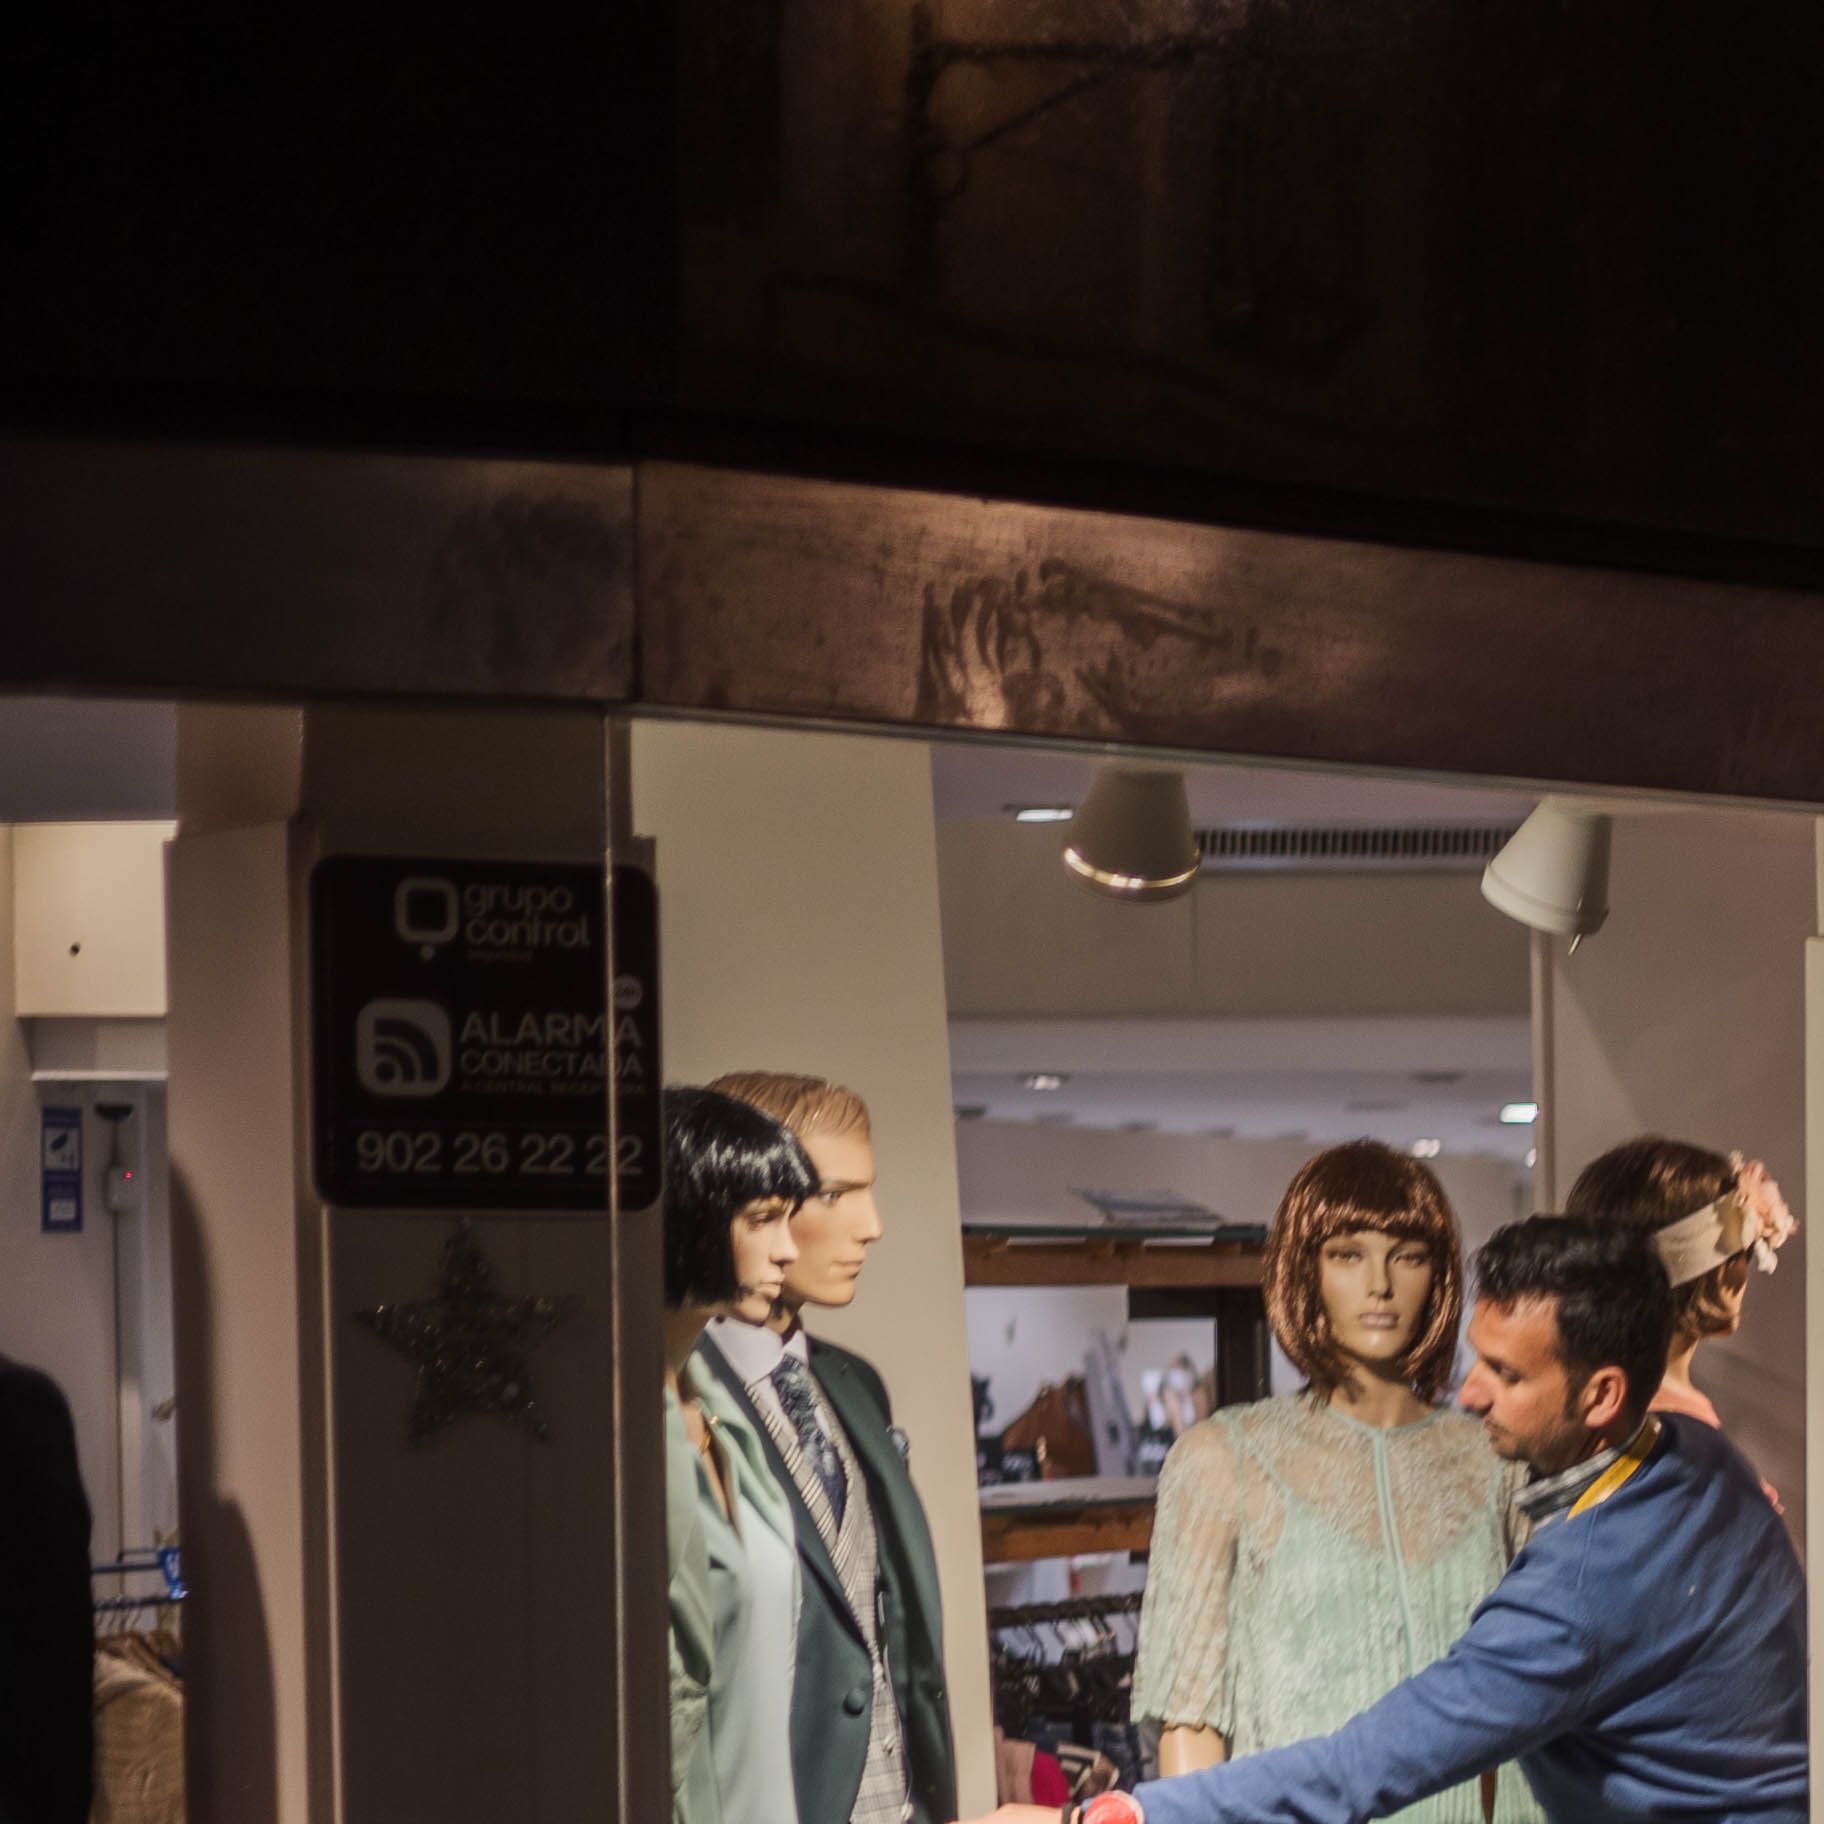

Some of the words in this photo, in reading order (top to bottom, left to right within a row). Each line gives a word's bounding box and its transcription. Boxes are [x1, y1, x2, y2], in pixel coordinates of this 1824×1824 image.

[464, 882, 573, 917] grupo
[464, 914, 592, 948] control
[459, 1010, 642, 1047] ALARMA
[356, 1131, 442, 1173] 902
[452, 1133, 508, 1174] 26
[518, 1134, 575, 1175] 22
[584, 1135, 643, 1176] 22
